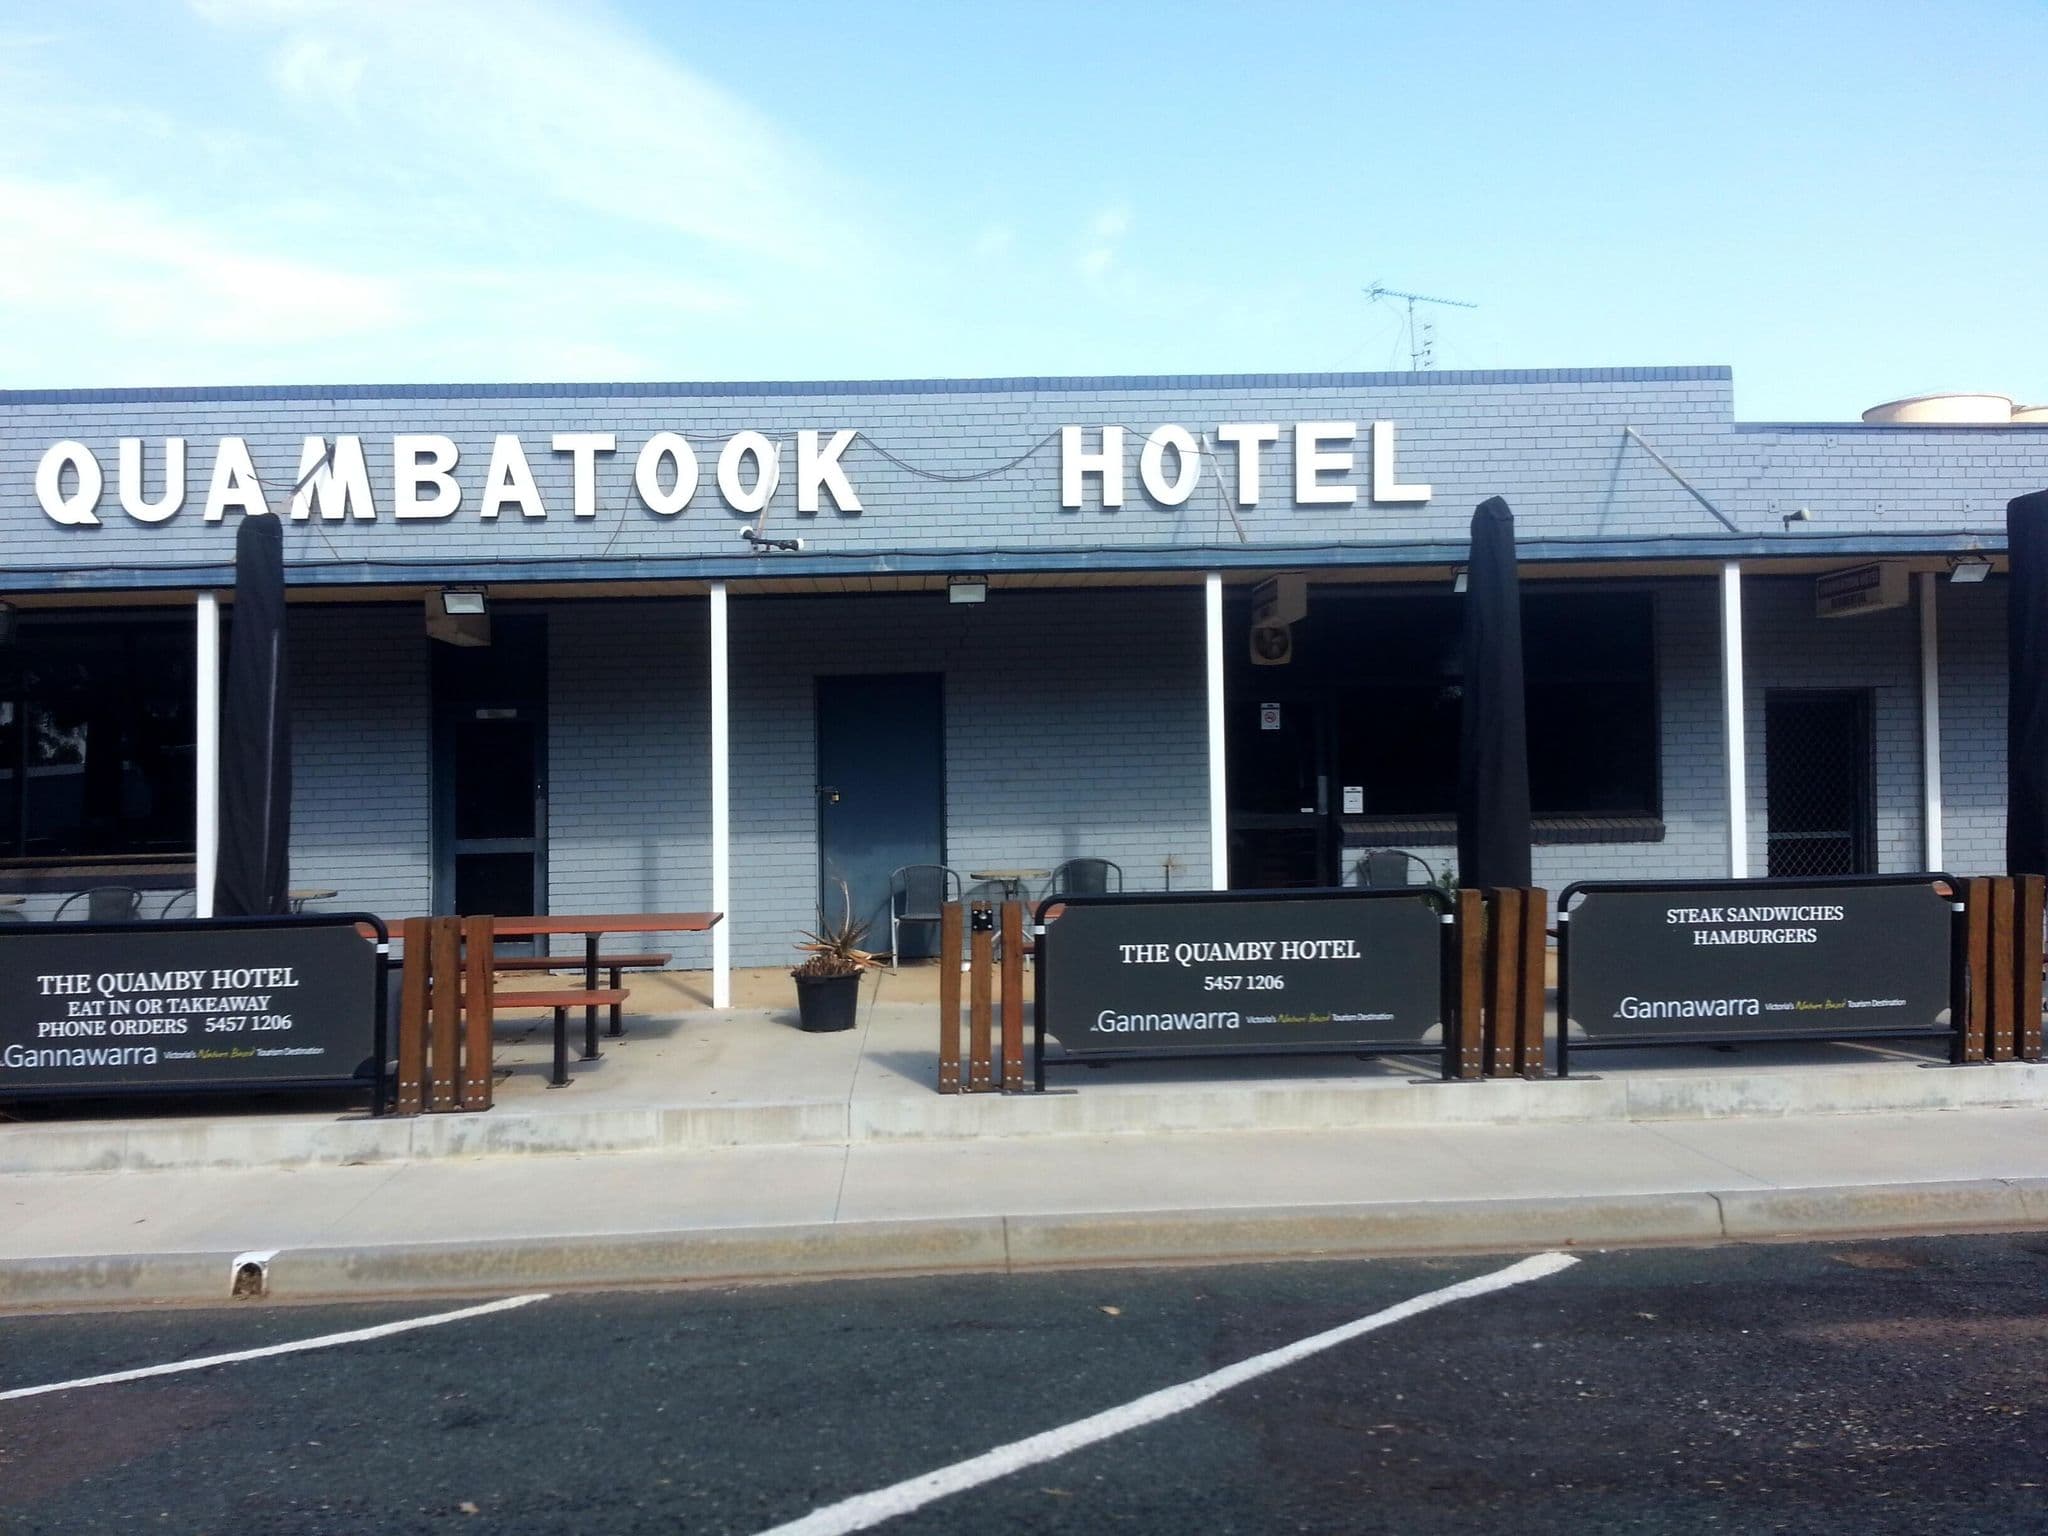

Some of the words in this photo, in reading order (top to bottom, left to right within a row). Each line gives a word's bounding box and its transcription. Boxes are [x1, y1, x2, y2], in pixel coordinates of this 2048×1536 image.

[35, 430, 862, 525] QUAMBATOOK
[1062, 421, 1431, 506] HOTEL
[1666, 908, 1723, 924] STEAK
[1727, 906, 1844, 922] SANDWICHES
[1693, 928, 1817, 945] HAMBURGERS
[1120, 944, 1169, 964] THE
[1174, 942, 1276, 967] QUAMBY
[1281, 940, 1360, 960] HOTEL
[37, 974, 91, 995] THE
[97, 970, 204, 997] QUAMBY
[212, 967, 299, 989] HOTEL
[1204, 976, 1242, 991] 5457
[1246, 975, 1284, 990] 1206
[68, 1000, 103, 1017] EAT
[108, 999, 131, 1015] IN
[135, 998, 164, 1014] OR
[165, 996, 272, 1013] TAKEAWAY
[1620, 997, 1759, 1019] Gannawarra
[37, 1020, 106, 1038] PHONE
[110, 1018, 187, 1036] ORDERS
[205, 1017, 246, 1032] 5457
[251, 1015, 292, 1031] 1206
[1098, 1010, 1240, 1032] Gannawarra
[4, 1044, 157, 1068] Gannawarra
